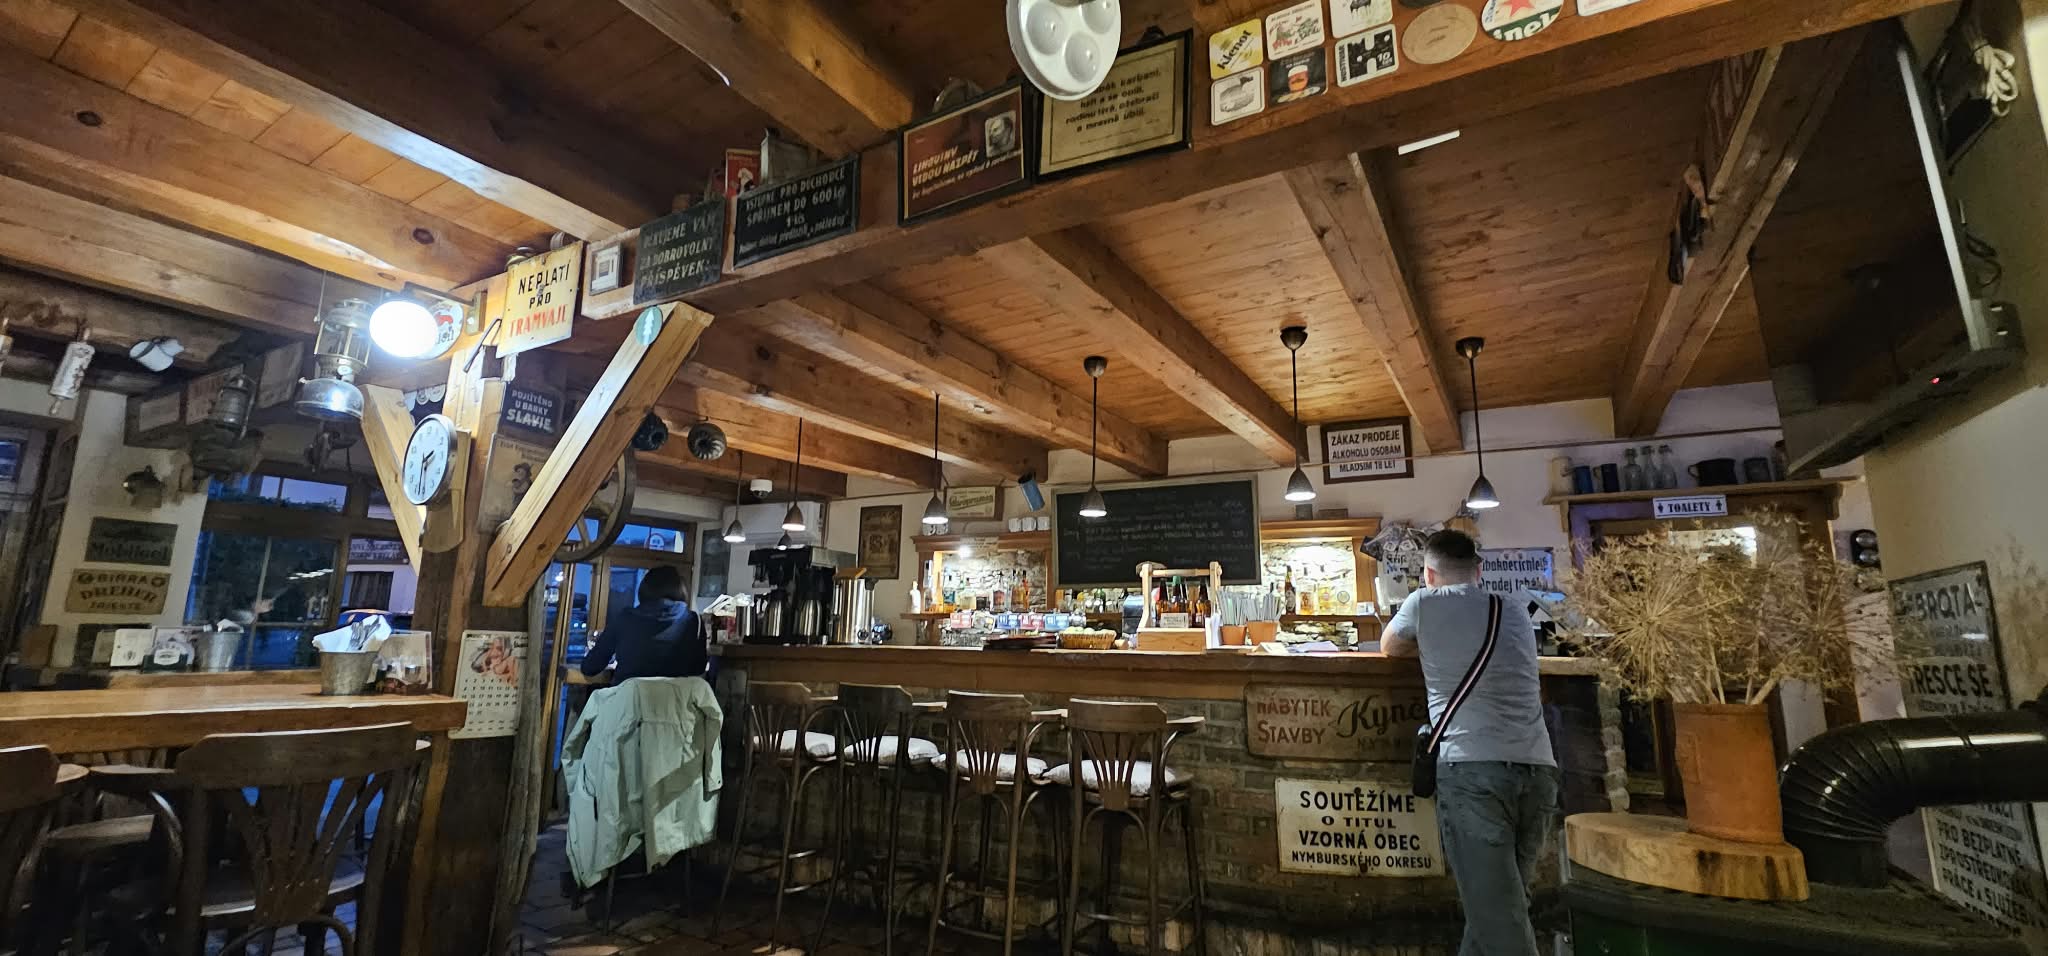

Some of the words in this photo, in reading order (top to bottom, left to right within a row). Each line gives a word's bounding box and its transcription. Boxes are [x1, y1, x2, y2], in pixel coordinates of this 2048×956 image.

[794, 196, 806, 211] DO
[812, 187, 833, 206] 600
[529, 291, 551, 309] PRO
[506, 408, 553, 431] SLAVIE
[1331, 432, 1359, 446] ZÁKAZ
[1362, 429, 1400, 443] PRODEJE
[1332, 448, 1368, 459] ALKOHOLU
[1370, 444, 1401, 457] OSOBÁM
[1384, 460, 1396, 469] LET
[1668, 501, 1710, 513] TOALETY
[1967, 663, 1994, 698] SE
[1257, 692, 1331, 717] NÁBYTEK
[1257, 720, 1326, 745] STAVBY
[1300, 789, 1416, 813] SOUTĚŽÍME
[1321, 815, 1335, 826] O
[1343, 817, 1396, 829] TITUL
[1299, 829, 1368, 849] VZORNÁ
[1374, 834, 1421, 851] OBEC
[1291, 850, 1381, 868] NYMBURSKÉHO
[1385, 855, 1432, 869] OKRESU
